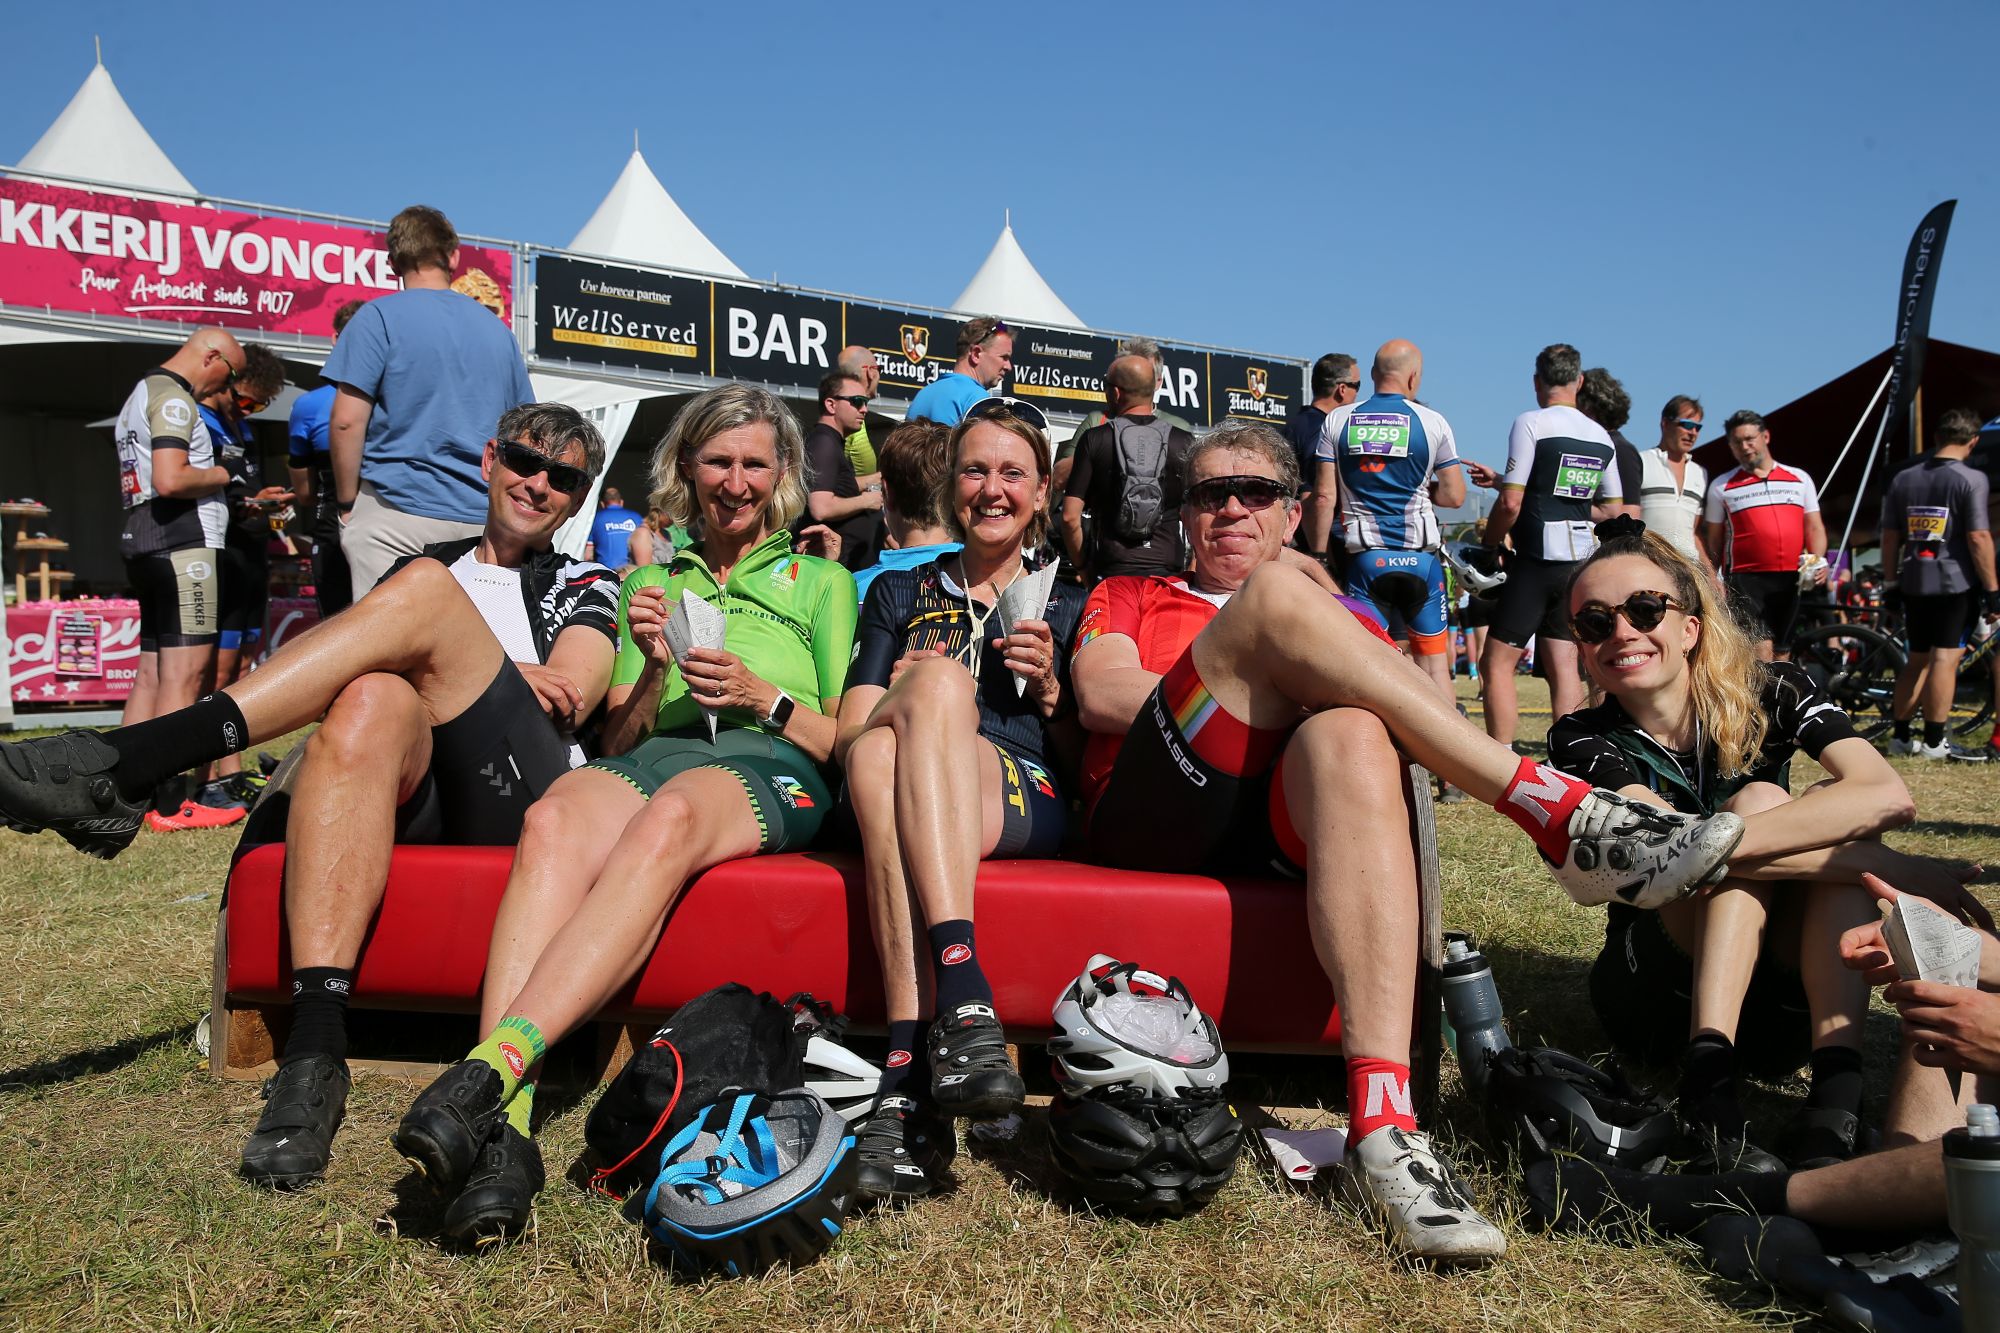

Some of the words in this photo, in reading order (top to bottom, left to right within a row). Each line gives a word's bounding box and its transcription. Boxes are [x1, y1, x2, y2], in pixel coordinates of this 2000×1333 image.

[0, 198, 181, 275] KKERIJ
[191, 225, 405, 290] VONCKE
[79, 268, 120, 294] Puur
[131, 274, 207, 302] Ambacht
[213, 286, 248, 306] sinds
[257, 290, 294, 315] 1907
[580, 279, 599, 292] Uw
[600, 282, 635, 297] horeca
[637, 289, 672, 303] partner
[552, 304, 697, 345] WellServed
[728, 307, 829, 368] BAR
[555, 331, 597, 343] HORECA
[602, 336, 644, 349] PROJECT
[650, 342, 695, 356] SERVICES
[1031, 342, 1044, 352] Uw
[1069, 347, 1093, 359] partner
[873, 353, 926, 383] Hertog
[1152, 364, 1200, 409] AR
[1227, 392, 1266, 416] Hertog
[1265, 397, 1287, 419] Jan
[1356, 427, 1400, 442] 9759
[1566, 470, 1599, 485] 9634
[1388, 556, 1418, 567] KWS
[192, 581, 202, 589] K
[193, 591, 205, 626] DEKKER
[1439, 594, 1447, 622] KWS
[1654, 826, 1702, 874] LAKE
[956, 1004, 995, 1020] SIDI
[938, 1073, 970, 1087] SIDI
[893, 1164, 925, 1177] SIDI
